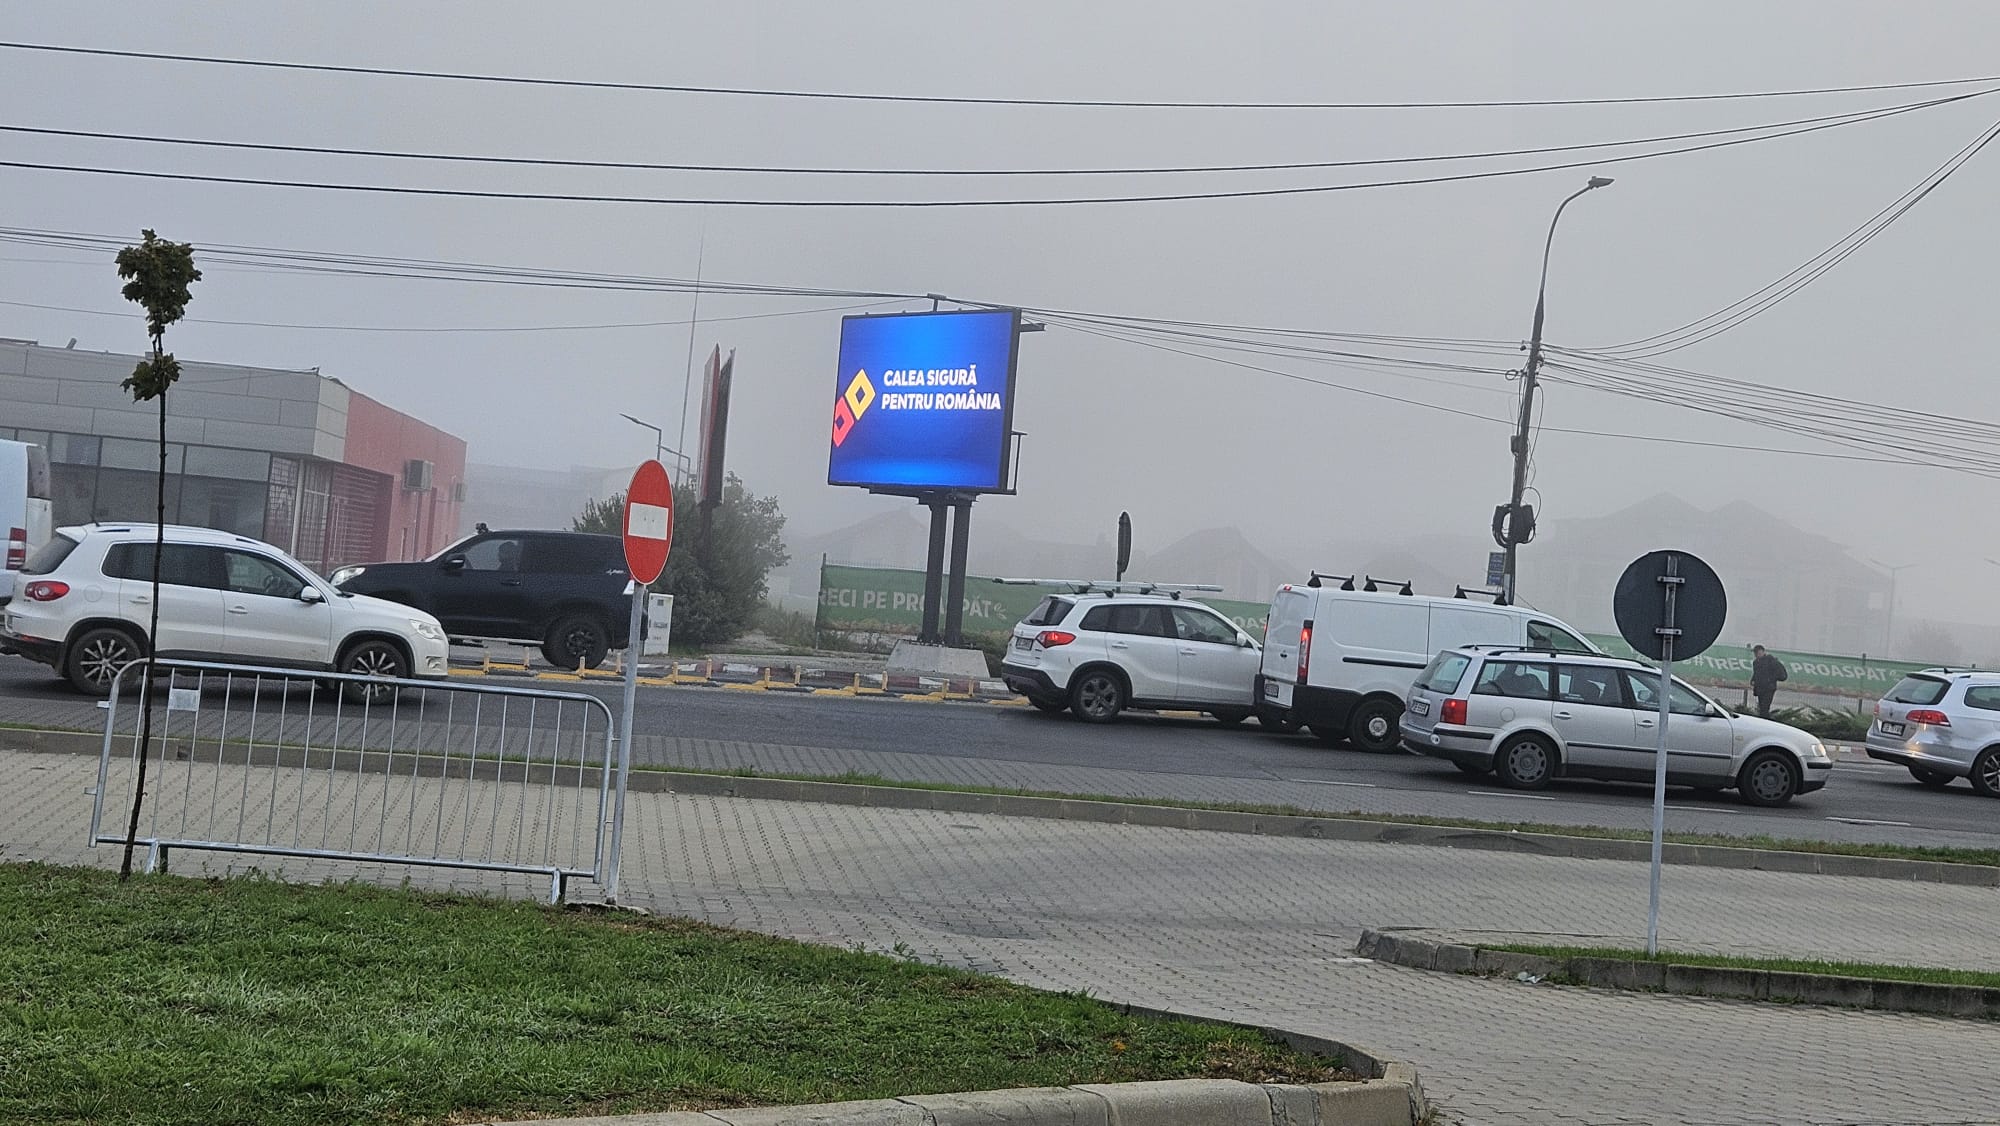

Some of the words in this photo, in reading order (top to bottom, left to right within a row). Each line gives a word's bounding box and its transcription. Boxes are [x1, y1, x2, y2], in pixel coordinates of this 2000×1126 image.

[883, 370, 925, 386] CALEA
[926, 364, 977, 386] SIGURĂ
[881, 393, 933, 410] PENTRU
[935, 388, 1001, 410] ROMÂNIA
[863, 590, 887, 609] PE
